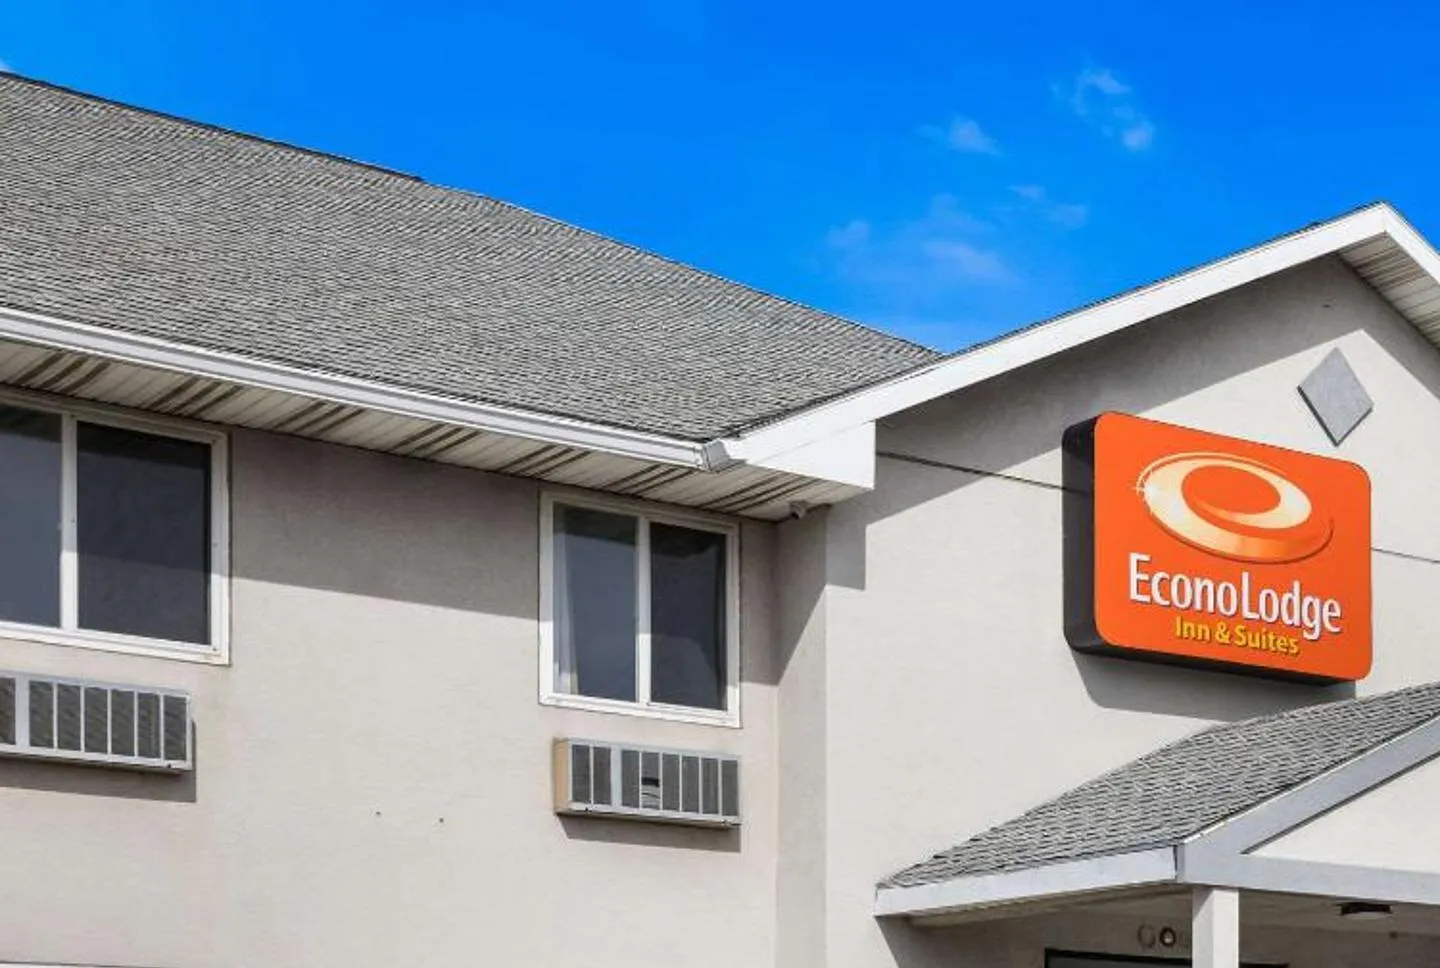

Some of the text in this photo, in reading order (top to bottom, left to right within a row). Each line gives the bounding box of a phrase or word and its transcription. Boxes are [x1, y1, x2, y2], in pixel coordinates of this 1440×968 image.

[1129, 552, 1342, 640] EconoLodge
[1174, 615, 1301, 655] Inn & Suites
